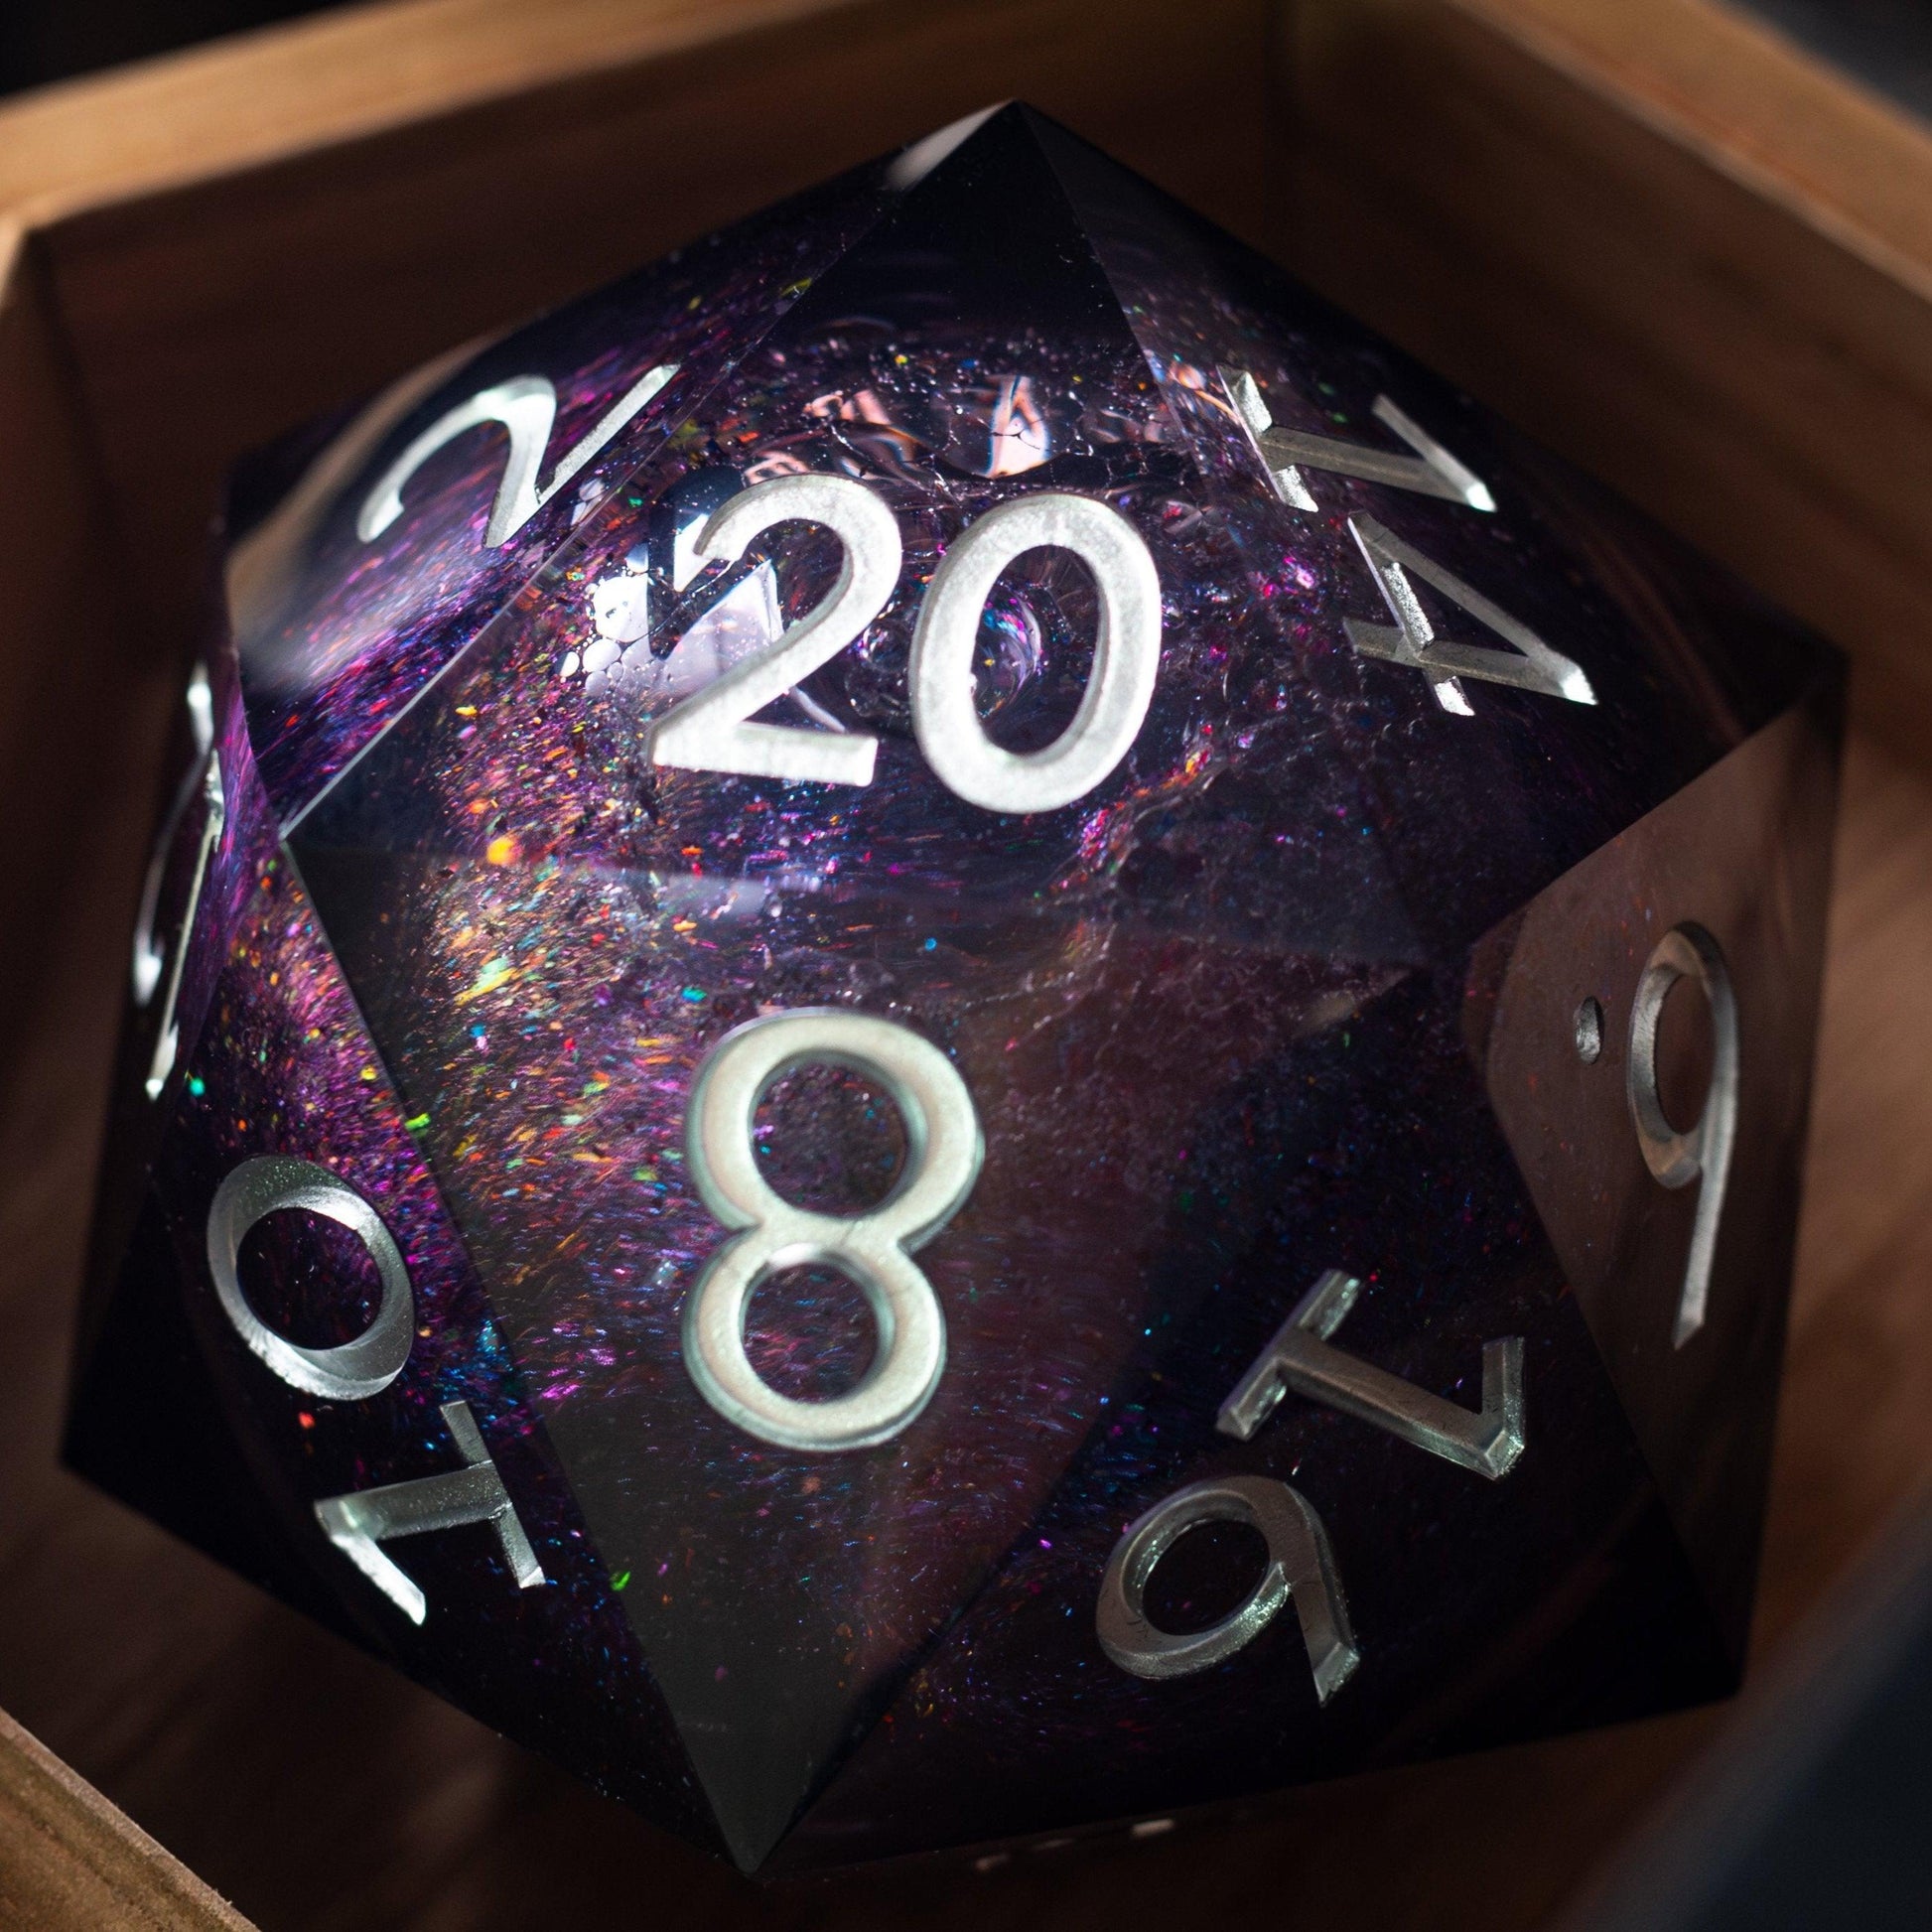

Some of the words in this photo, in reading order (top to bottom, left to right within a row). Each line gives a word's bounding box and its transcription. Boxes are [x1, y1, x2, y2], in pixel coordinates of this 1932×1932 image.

[357, 364, 680, 548] 2
[651, 473, 1162, 814] 20
[1216, 364, 1598, 717] 14
[207, 1155, 546, 1626] 10
[682, 1006, 986, 1452] 8
[1095, 1269, 1527, 1708] 16
